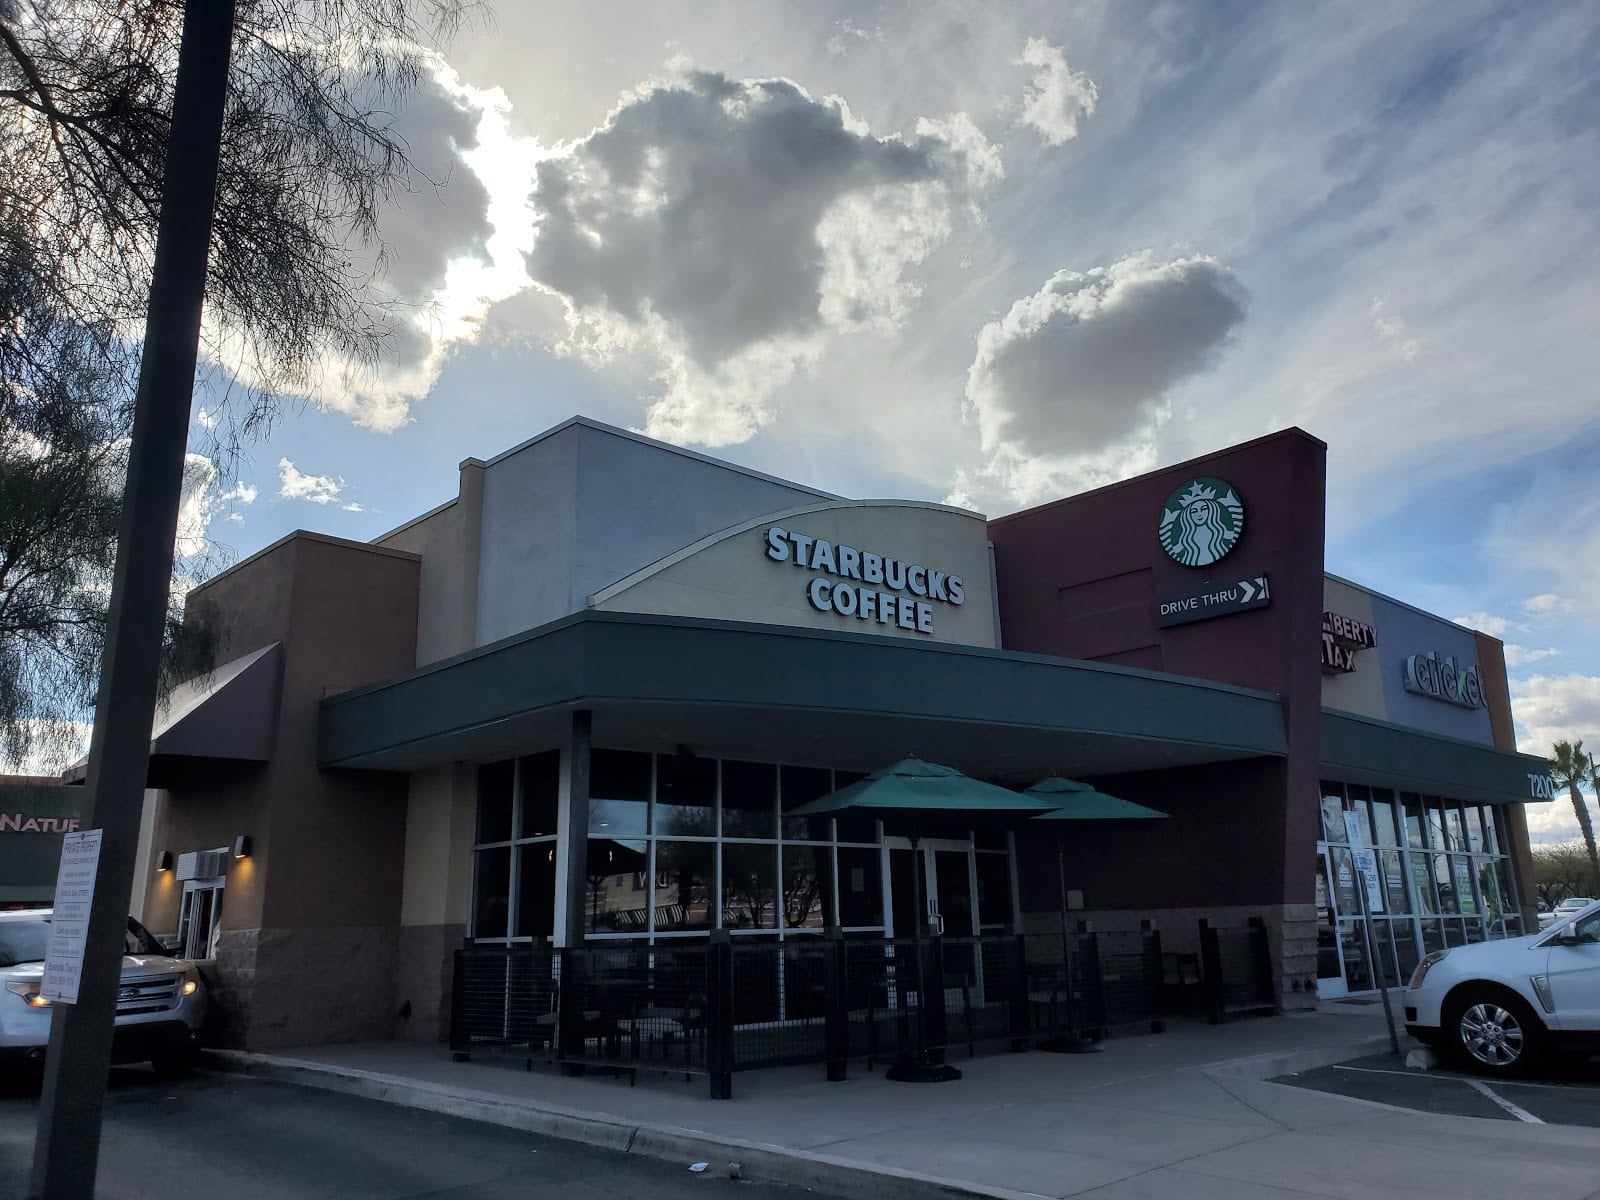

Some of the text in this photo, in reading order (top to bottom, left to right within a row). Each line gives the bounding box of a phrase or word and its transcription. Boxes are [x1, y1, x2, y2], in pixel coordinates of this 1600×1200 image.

[765, 527, 966, 605] STARBUCKS
[808, 577, 934, 634] COFFEE
[1160, 588, 1238, 615] DRIVE THRU
[1527, 773, 1553, 799] 7200
